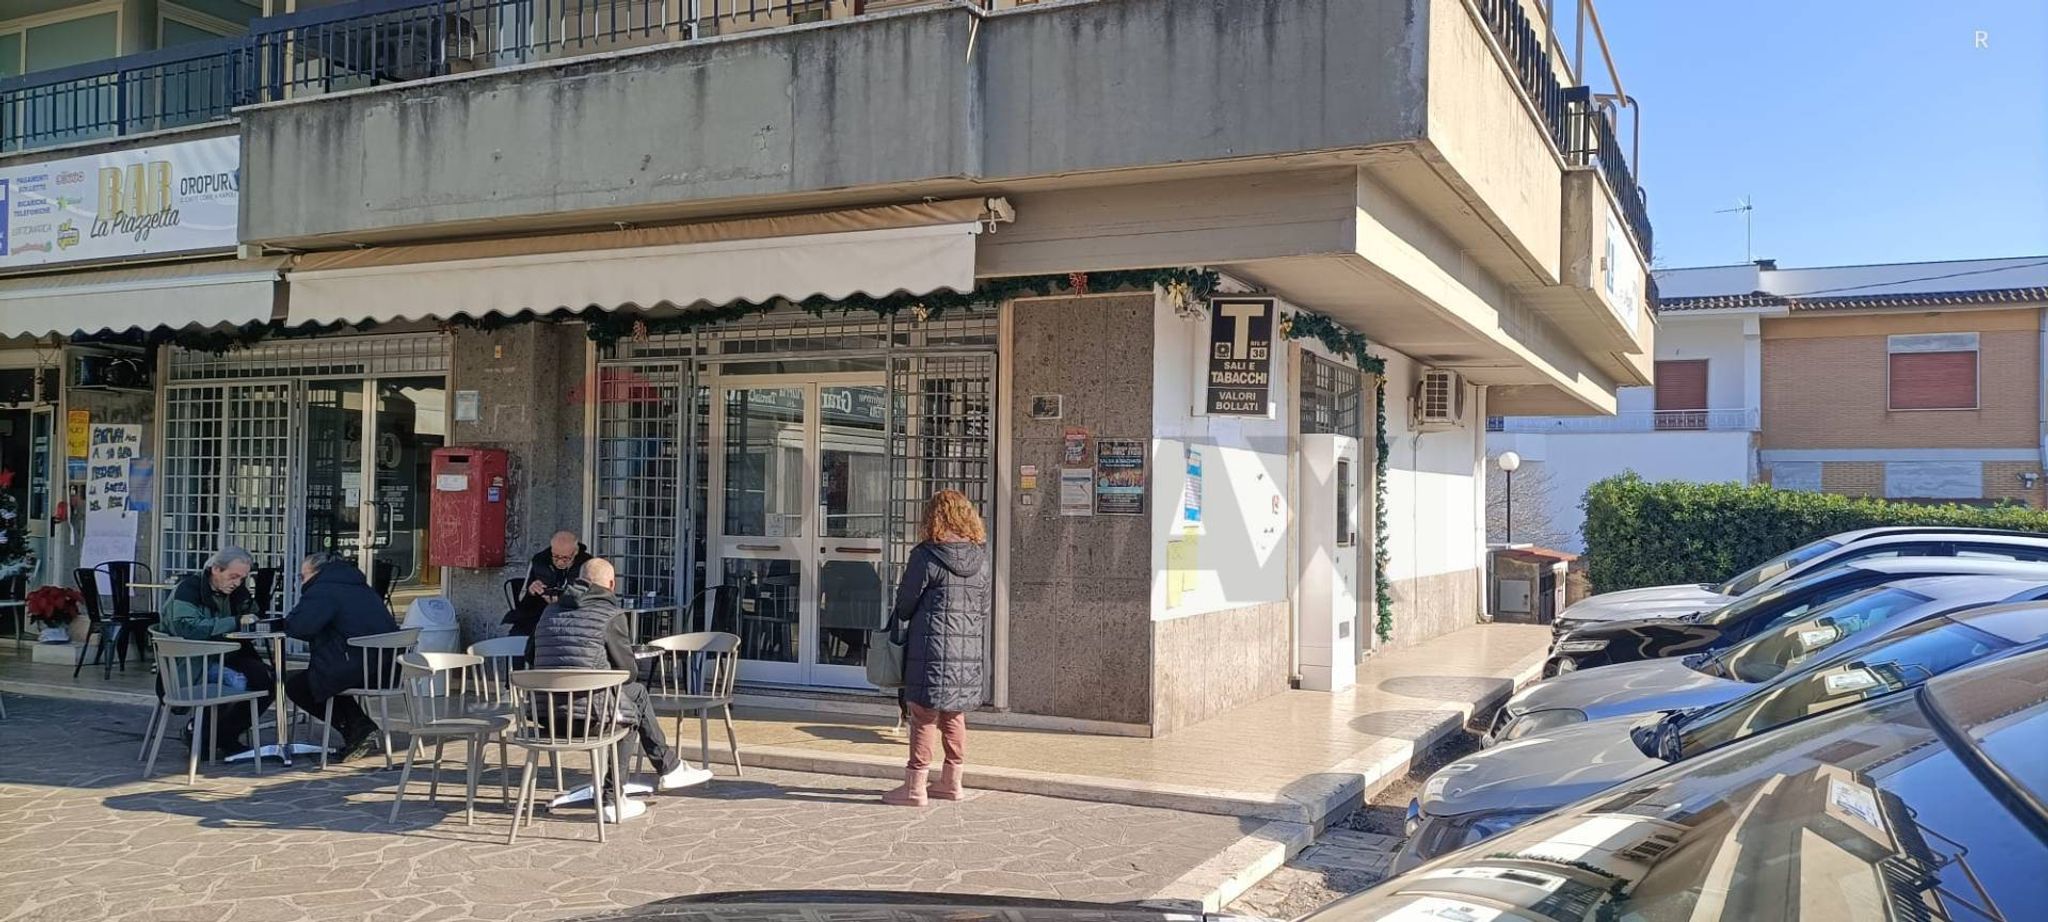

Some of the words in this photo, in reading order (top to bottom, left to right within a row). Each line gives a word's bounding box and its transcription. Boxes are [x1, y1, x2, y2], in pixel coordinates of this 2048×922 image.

[98, 161, 172, 220] BAR
[91, 215, 108, 237] La
[111, 204, 180, 242] Piazzetta
[1221, 304, 1265, 359] T
[1252, 349, 1265, 358] 38
[1224, 362, 1246, 370] SALI
[1249, 362, 1256, 370] E
[1211, 372, 1267, 384] TABACCHI
[1219, 392, 1256, 400] VALORI
[1215, 402, 1259, 411] BOLLATI
